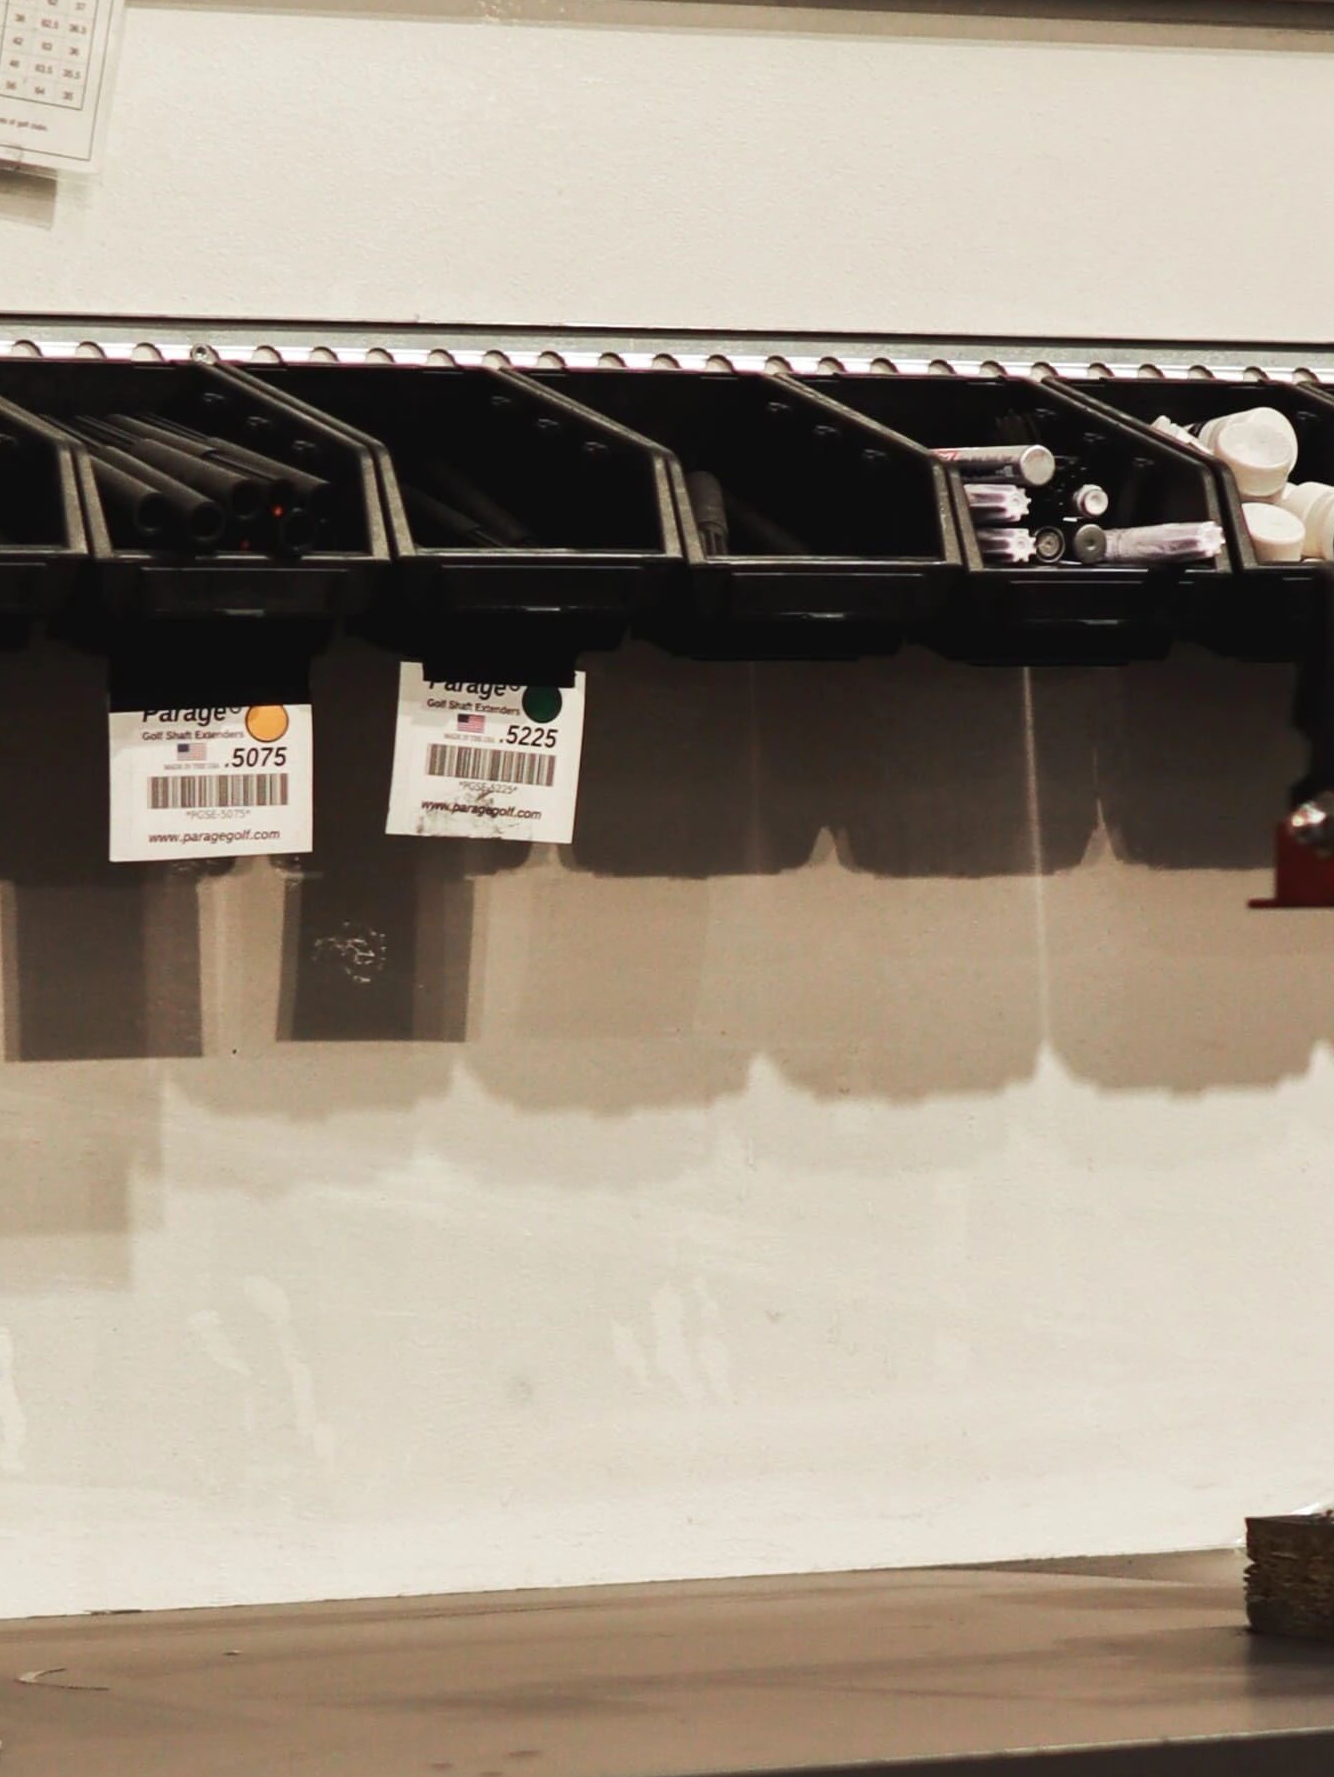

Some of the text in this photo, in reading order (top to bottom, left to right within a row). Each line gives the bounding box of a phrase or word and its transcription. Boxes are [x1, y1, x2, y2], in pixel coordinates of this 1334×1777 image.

[426, 698, 447, 709] Golf
[475, 703, 521, 716] Extenders
[142, 730, 245, 741] Golf Shaft Extenders
[499, 725, 559, 749] .5225
[224, 747, 288, 769] .5075
[147, 828, 281, 845] www.paragegolf.com
